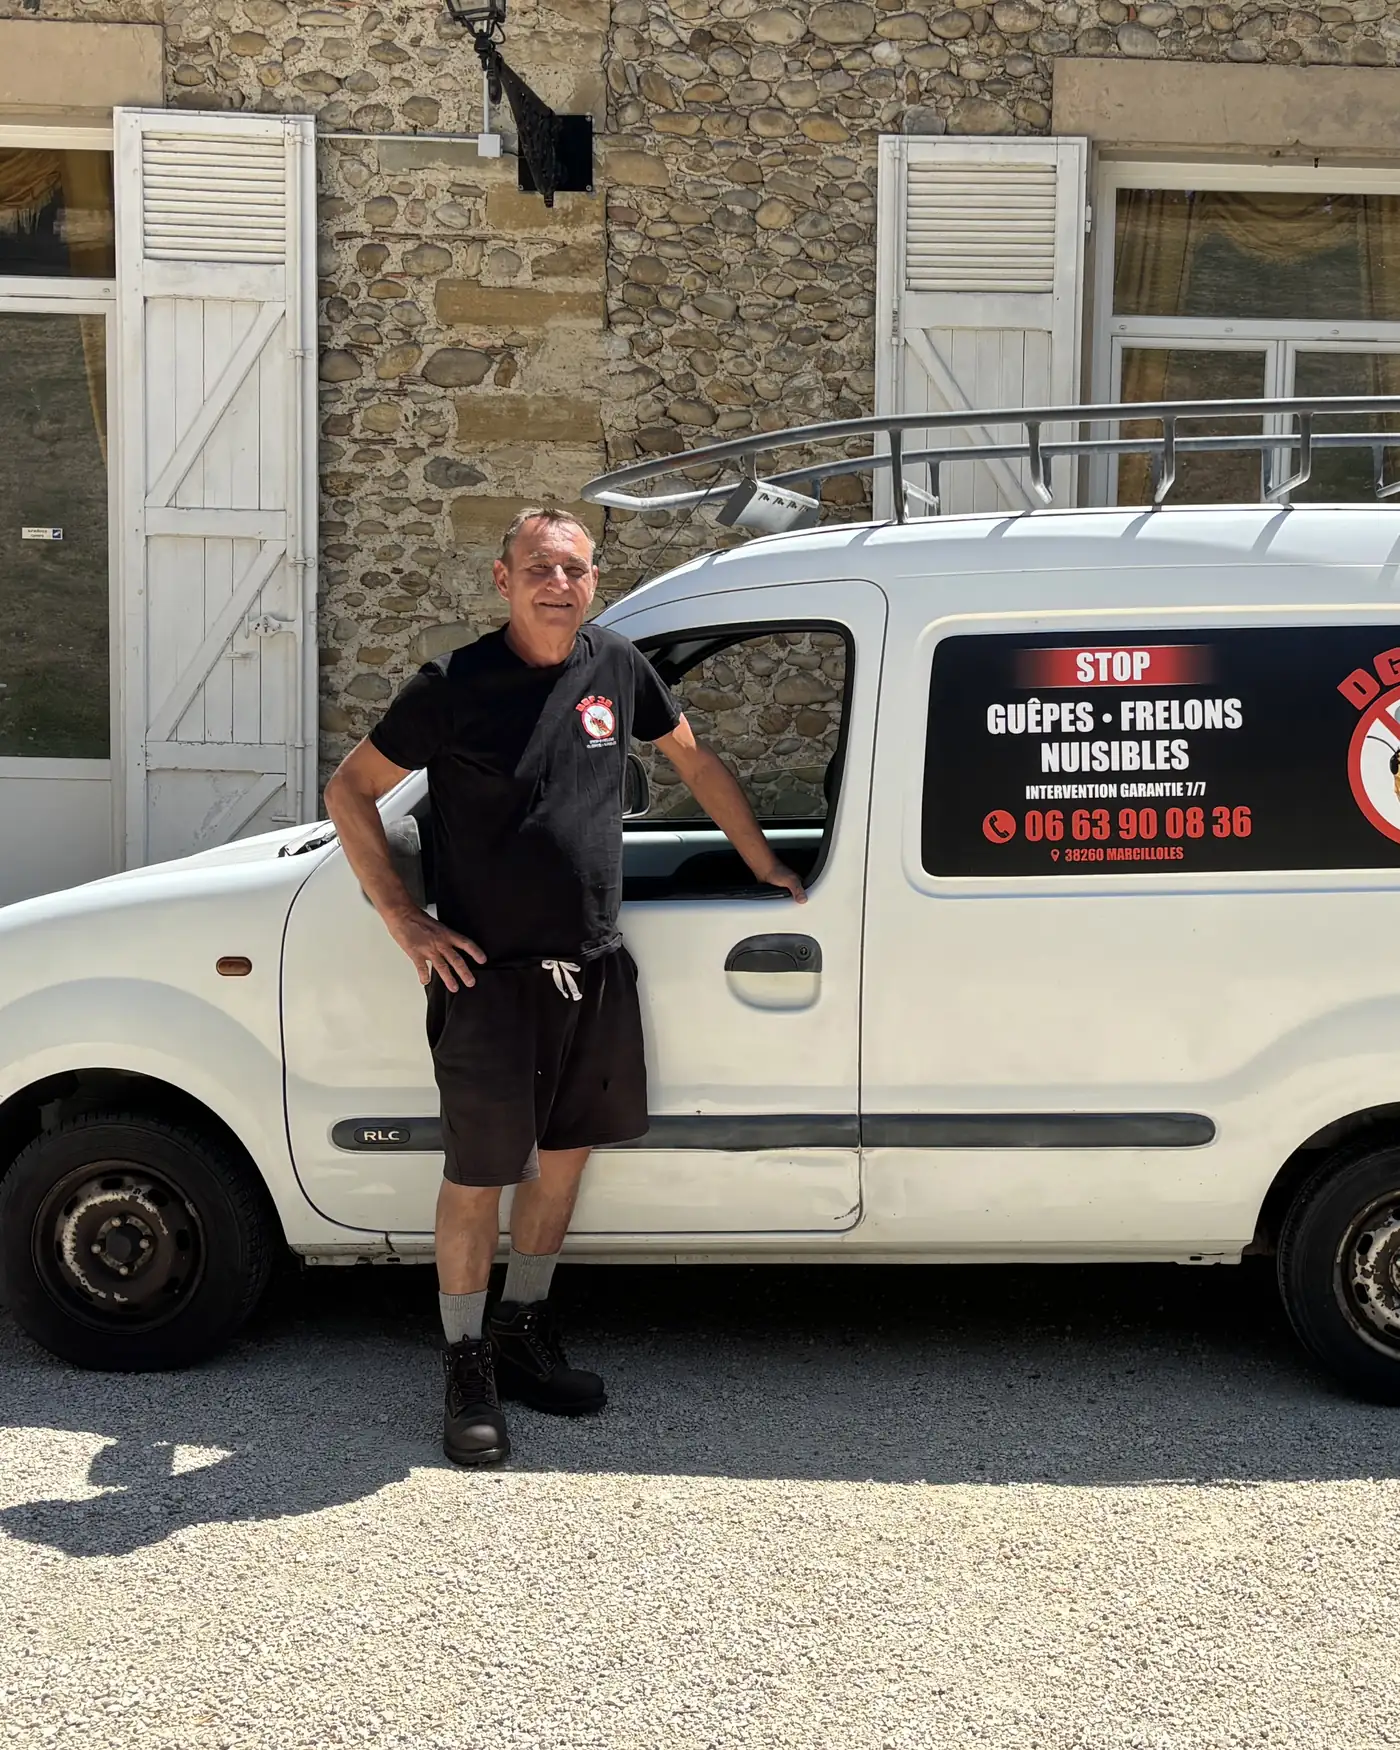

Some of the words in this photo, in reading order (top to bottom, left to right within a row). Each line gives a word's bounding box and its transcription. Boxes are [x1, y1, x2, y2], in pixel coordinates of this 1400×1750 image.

[1076, 651, 1150, 682] STOP
[986, 697, 1094, 735] GUÊPES
[1120, 698, 1243, 731] FRELONS
[1041, 739, 1190, 773] NUISIBLES
[1025, 783, 1118, 800] INTERVENTION
[1120, 782, 1183, 798] GARANTIE
[1185, 782, 1206, 796] 7/7
[1024, 809, 1064, 842] 06
[1071, 808, 1110, 841] 63
[1118, 807, 1158, 840] 90
[1165, 806, 1204, 839] 08
[1212, 805, 1251, 838] 36
[1064, 848, 1104, 862] 38260
[1106, 846, 1184, 861] MARCILLOLES
[363, 1130, 400, 1141] RLC
